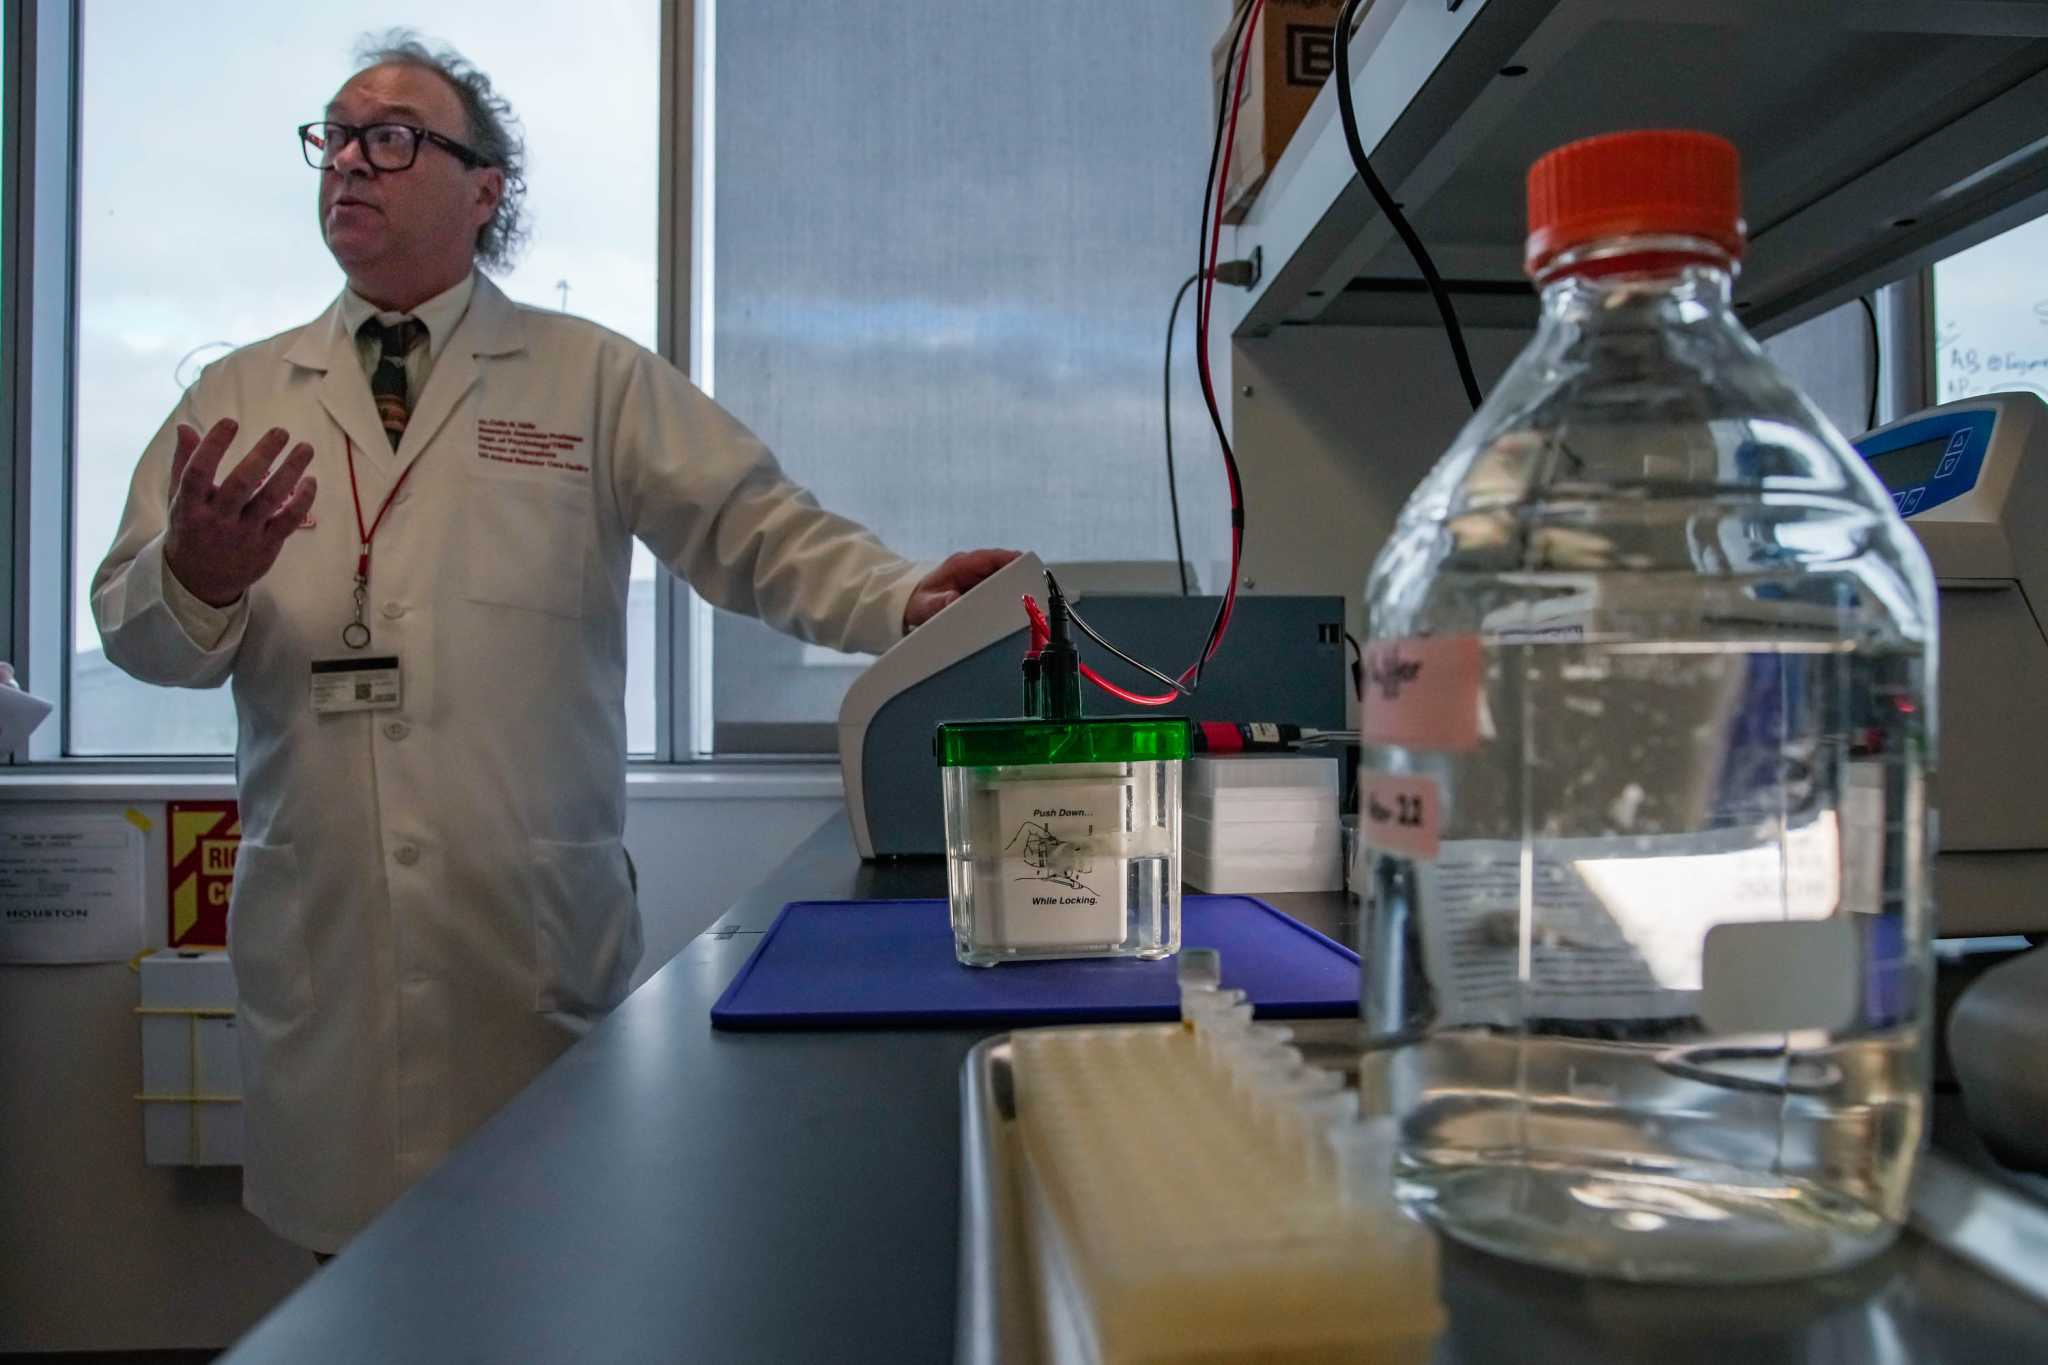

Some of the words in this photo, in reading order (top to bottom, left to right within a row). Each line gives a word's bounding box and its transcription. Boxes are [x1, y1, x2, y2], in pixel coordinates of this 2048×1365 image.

[1033, 808, 1057, 818] Push
[1032, 897, 1057, 906] While
[1059, 896, 1098, 906] Locking.
[6, 908, 88, 919] HOUSTON
